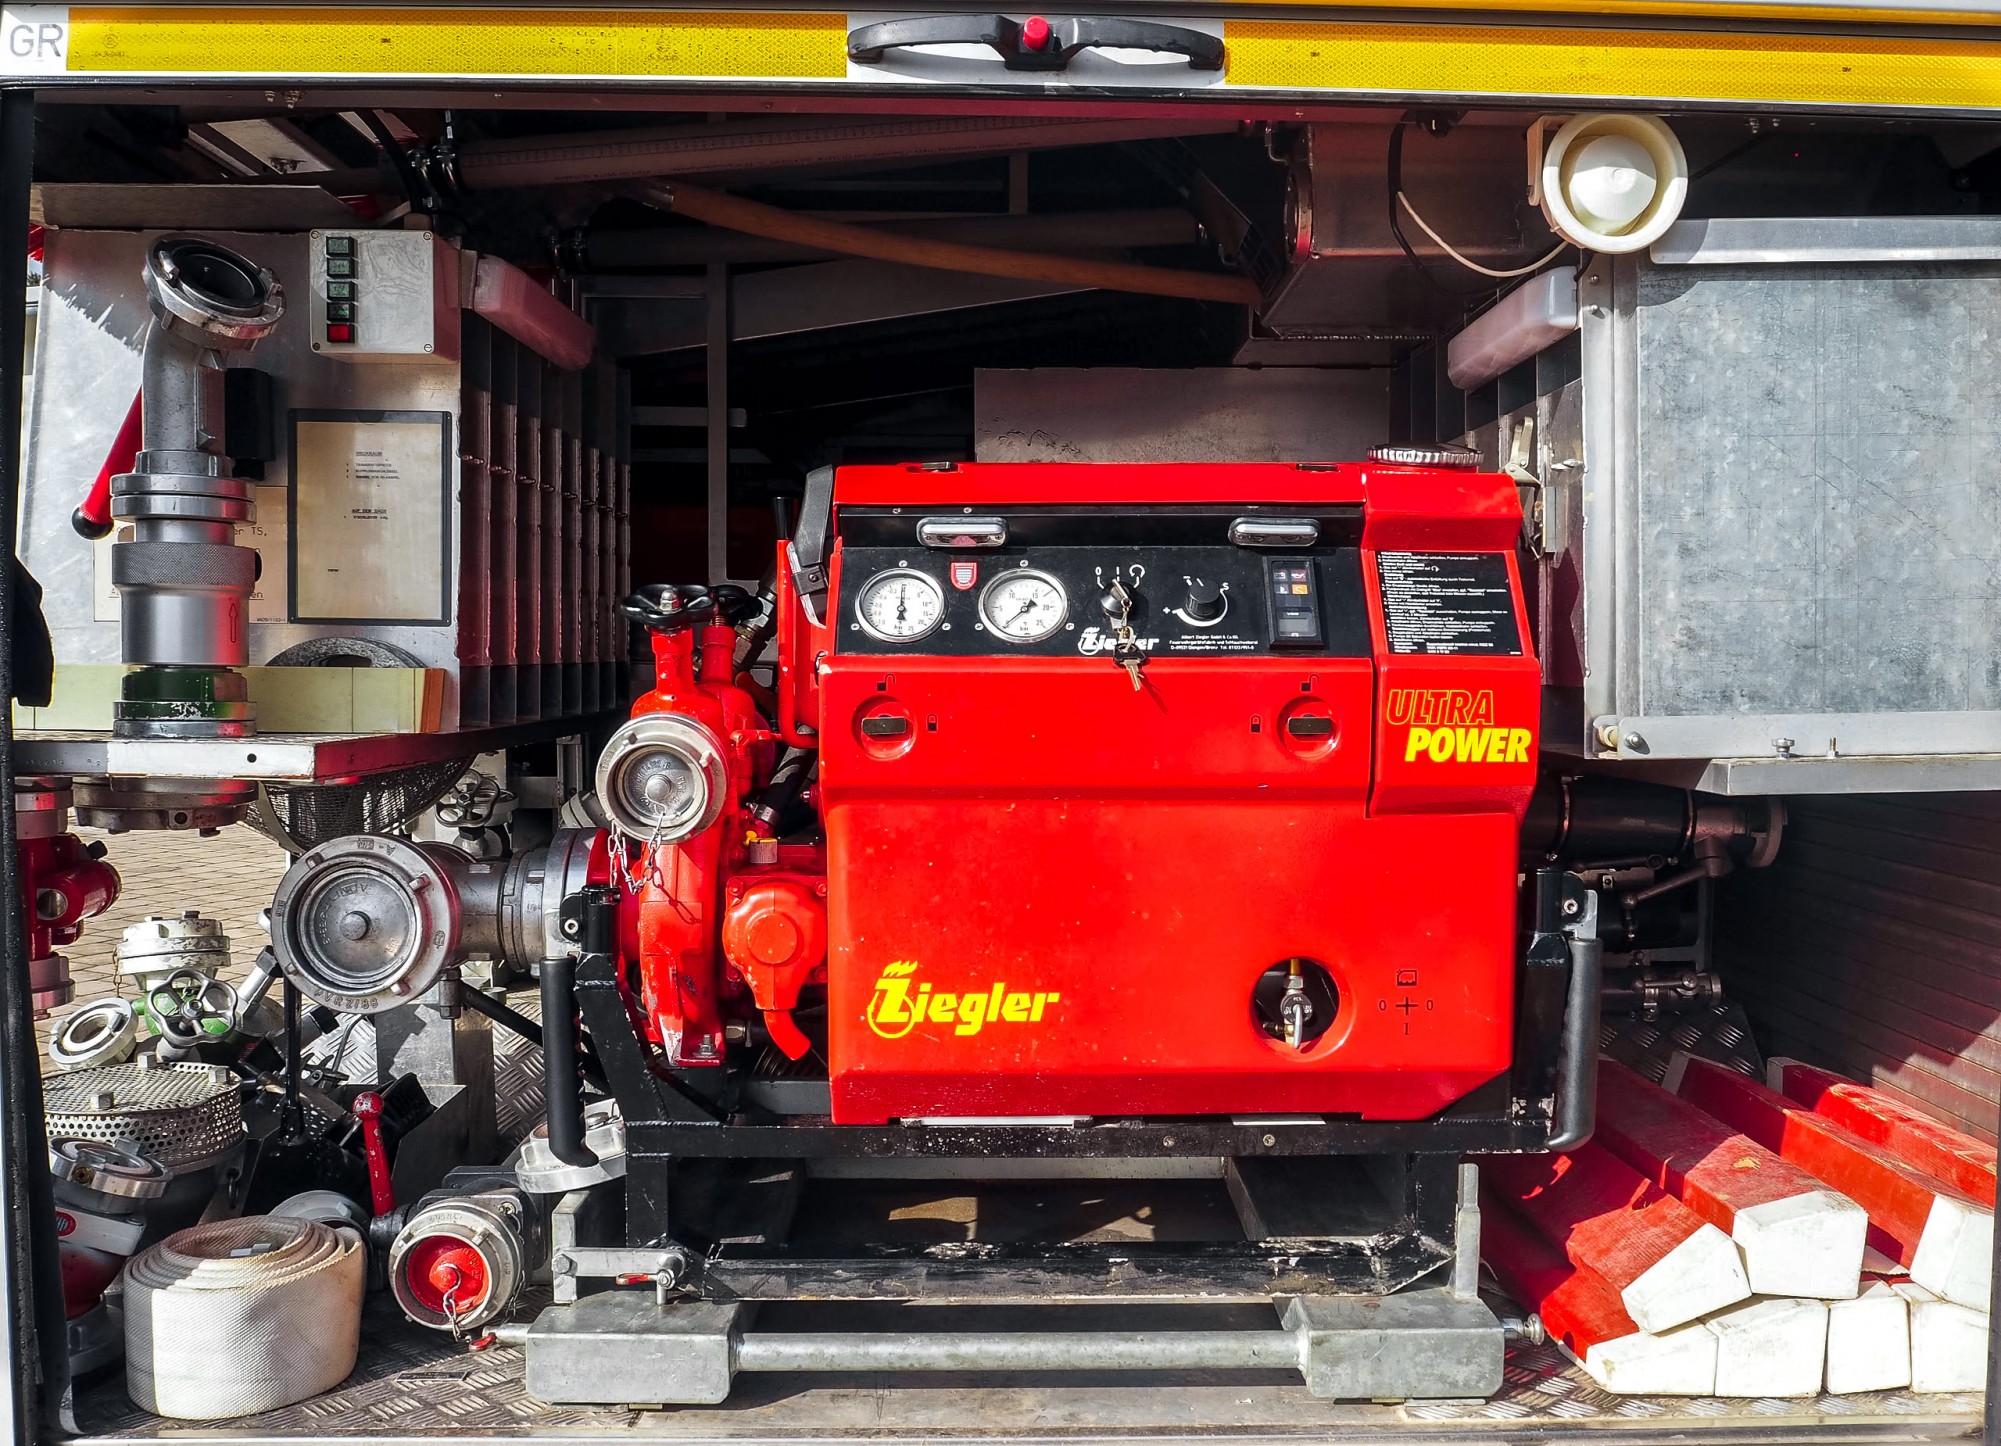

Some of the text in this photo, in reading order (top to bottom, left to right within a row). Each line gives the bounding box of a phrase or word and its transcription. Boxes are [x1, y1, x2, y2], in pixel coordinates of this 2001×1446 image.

[9, 23, 63, 57] GR
[1386, 689, 1494, 726] ULTRA
[1404, 726, 1532, 763] POWER
[867, 975, 1061, 1039] Ziegler
